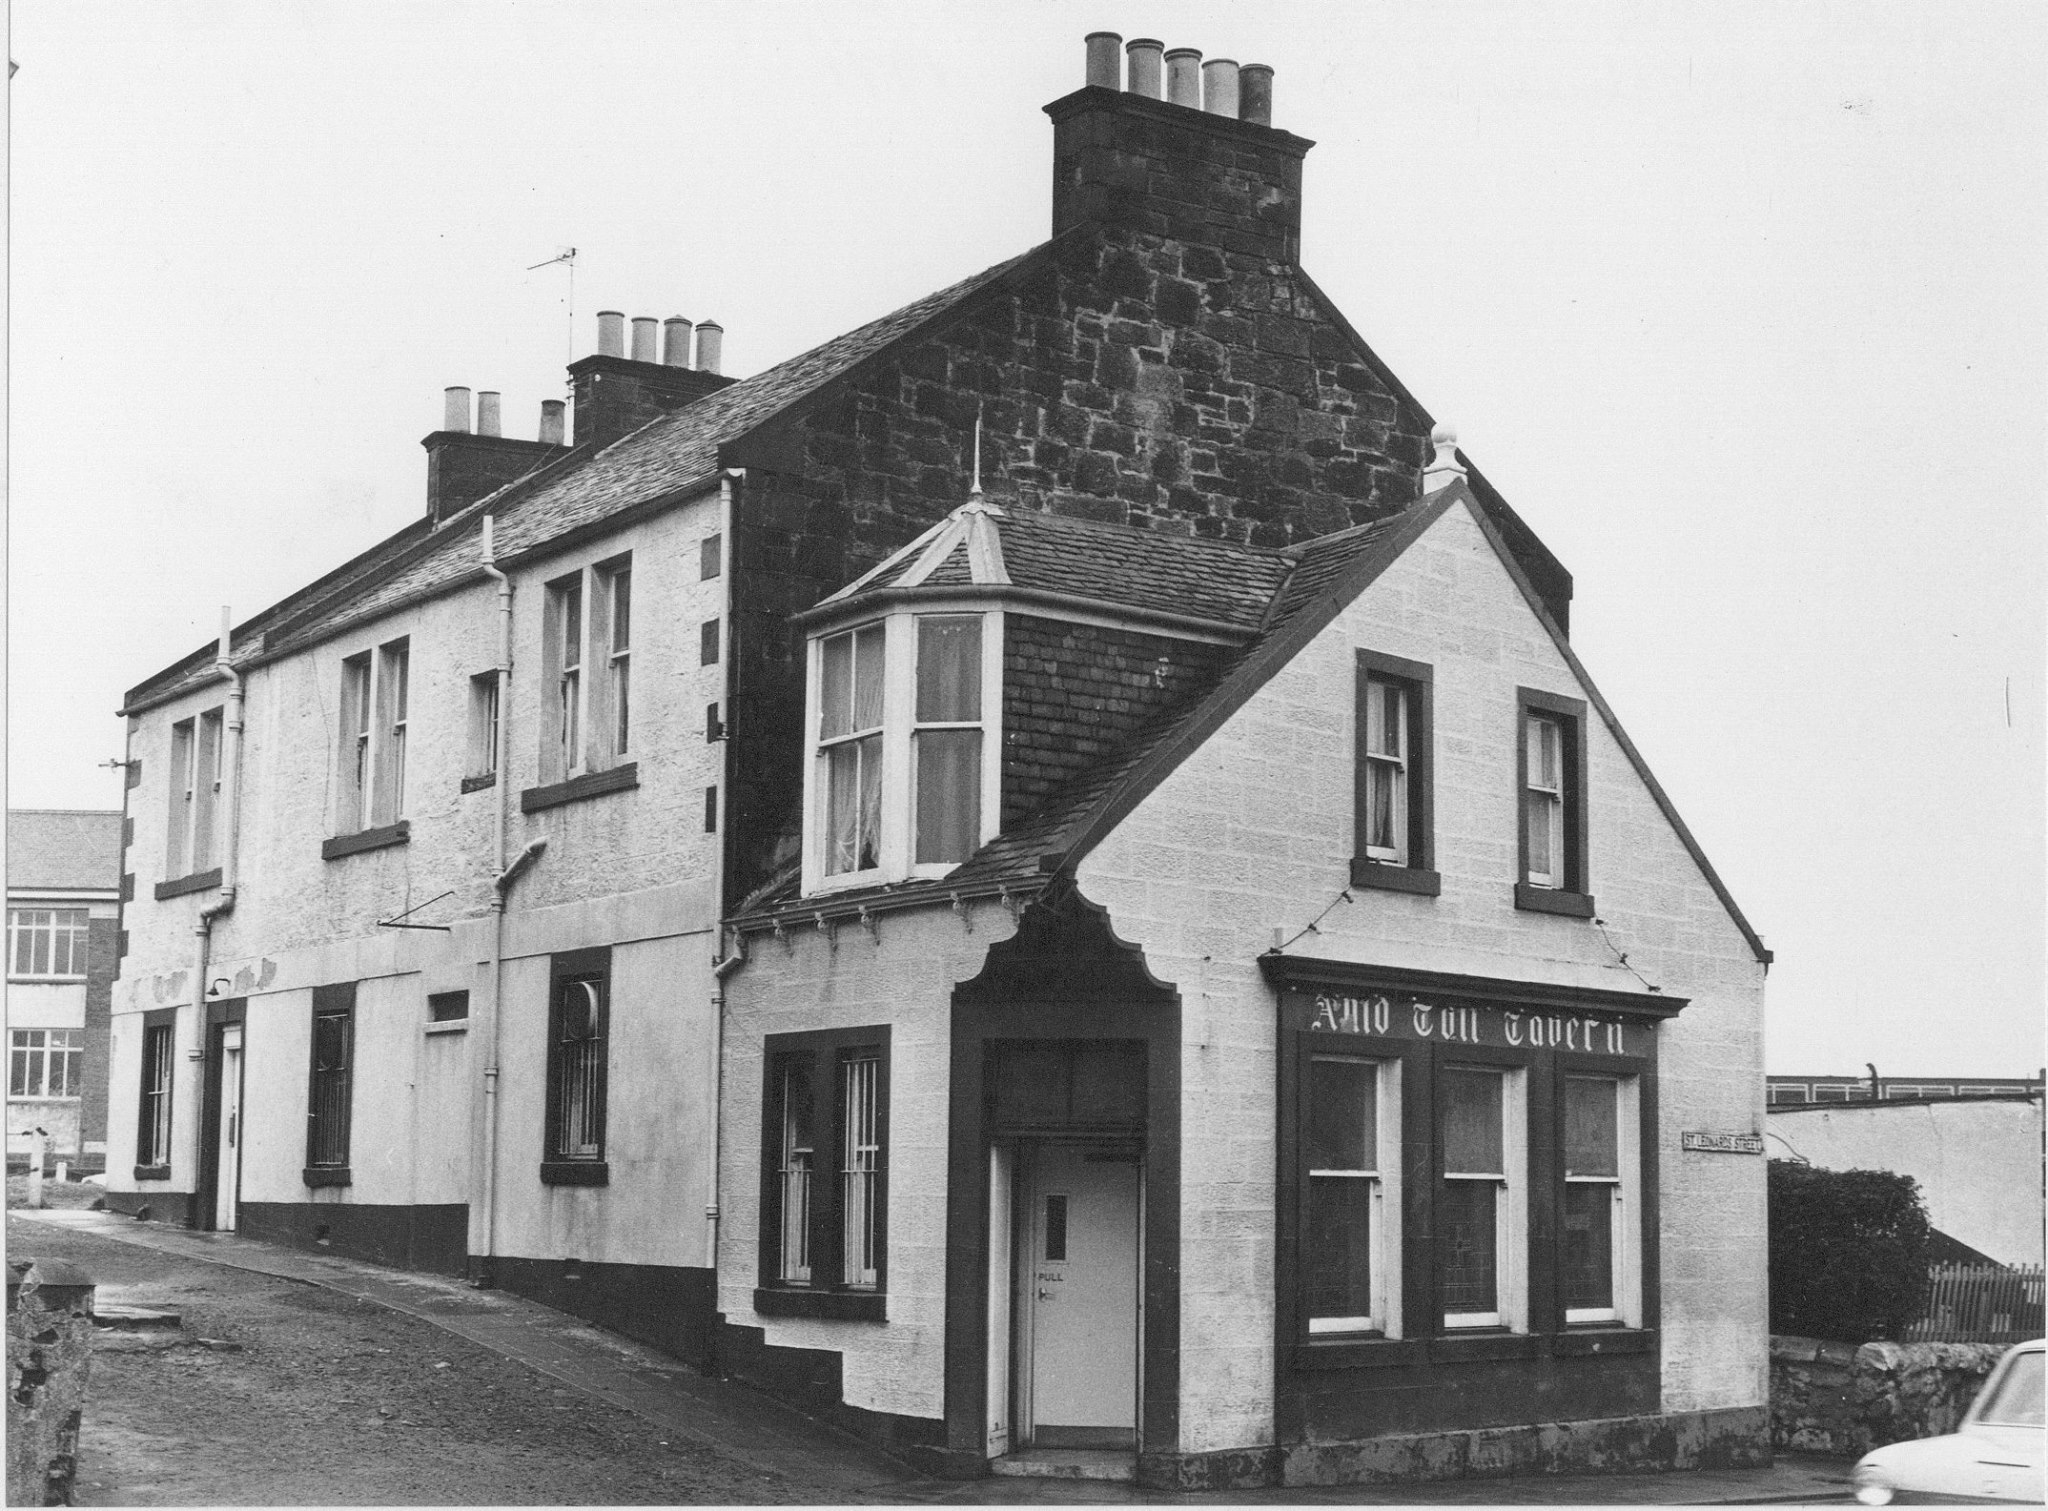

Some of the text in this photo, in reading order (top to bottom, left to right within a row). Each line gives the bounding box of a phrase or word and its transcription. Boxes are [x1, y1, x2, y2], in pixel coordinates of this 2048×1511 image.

[1504, 1012, 1624, 1054] Tavern
[1735, 1137, 1760, 1152] STREET
[1039, 1273, 1063, 1281] PULL
